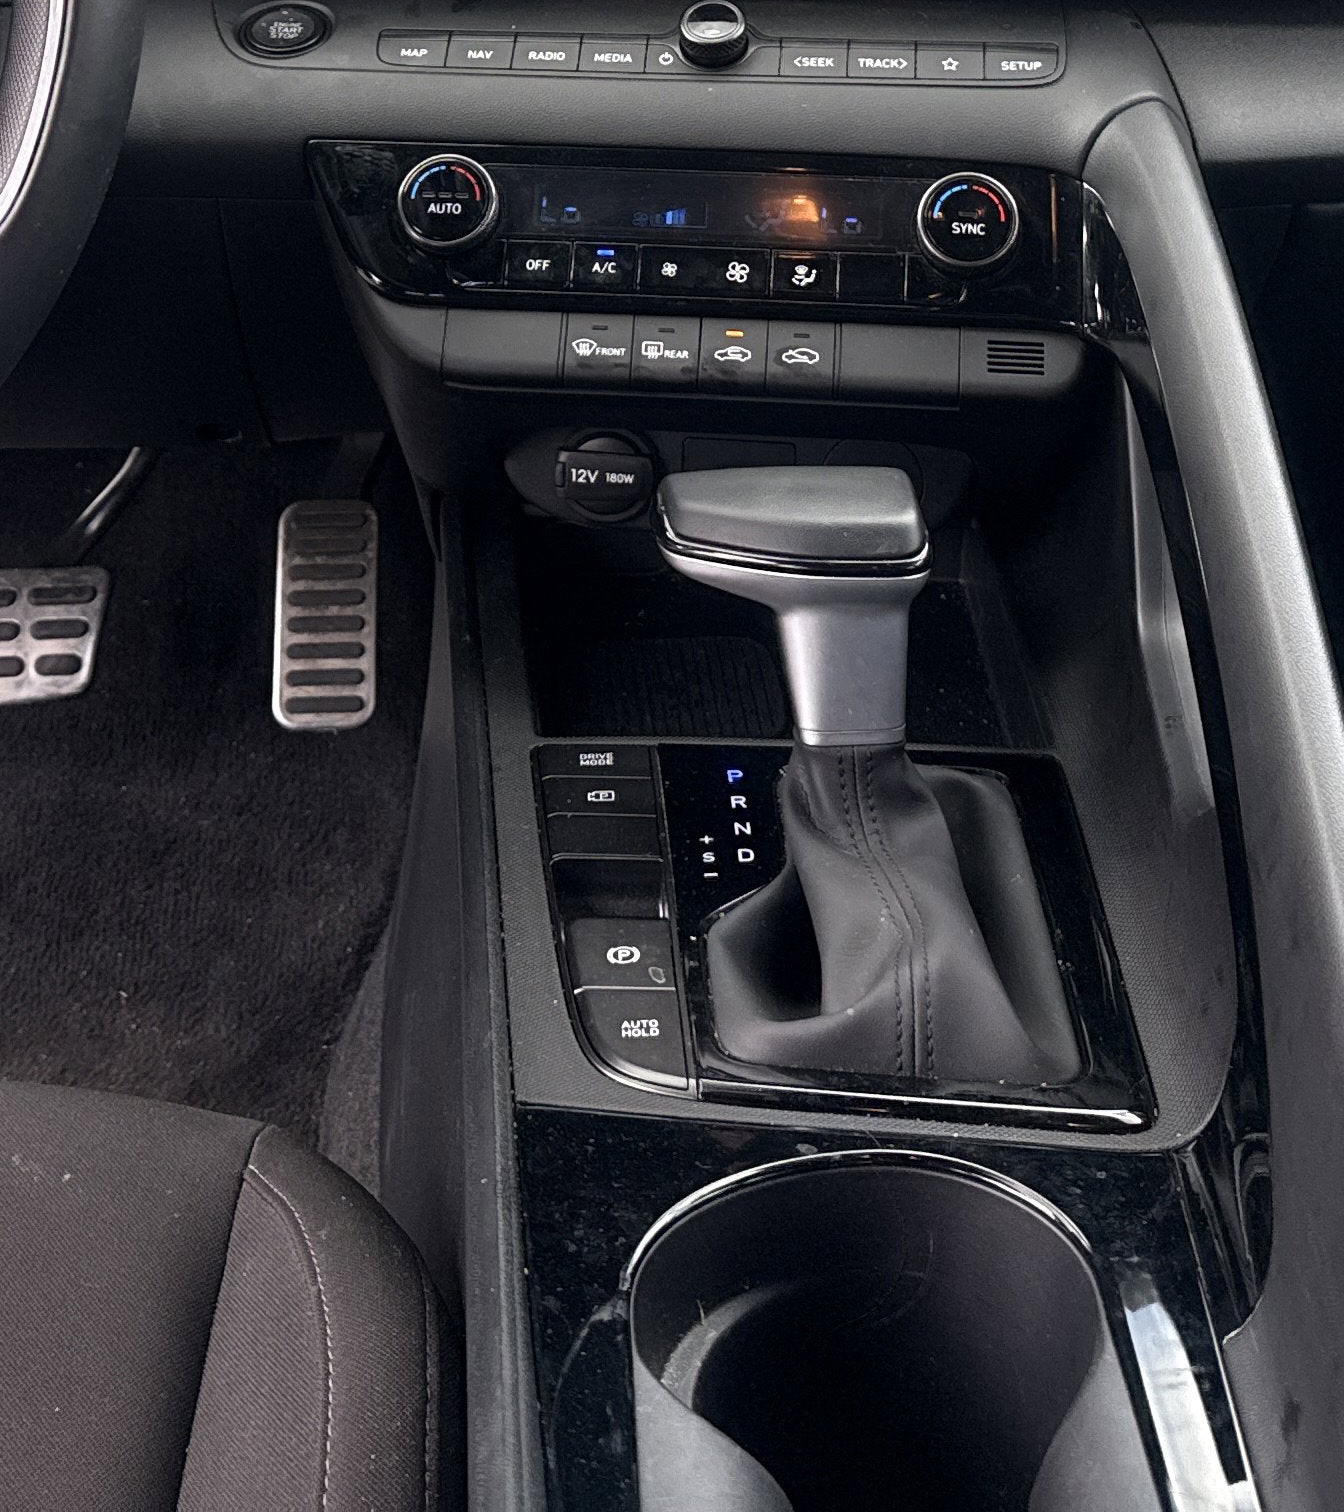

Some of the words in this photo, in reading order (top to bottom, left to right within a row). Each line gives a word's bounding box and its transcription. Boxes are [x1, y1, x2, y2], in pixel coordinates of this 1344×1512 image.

[269, 25, 304, 34] START
[400, 48, 428, 57] MAP
[467, 49, 493, 59] NAV
[528, 51, 566, 61] RADIO
[594, 53, 633, 63] MEDIA
[1001, 60, 1042, 71] SETUP
[427, 203, 462, 214] AUTO
[952, 222, 986, 235] SYNC
[526, 259, 551, 270] OFF
[592, 262, 616, 274] A/C
[595, 347, 626, 356] FRONT
[664, 349, 689, 359] REAR
[570, 468, 599, 483] 12V
[605, 472, 635, 484] 180W
[580, 758, 613, 766] MODE
[727, 769, 743, 782] P
[730, 795, 747, 808] R
[734, 822, 751, 835] N
[702, 851, 715, 862] S
[737, 848, 755, 862] D
[621, 1019, 658, 1028] AUTO
[621, 1027, 660, 1037] HOLD
